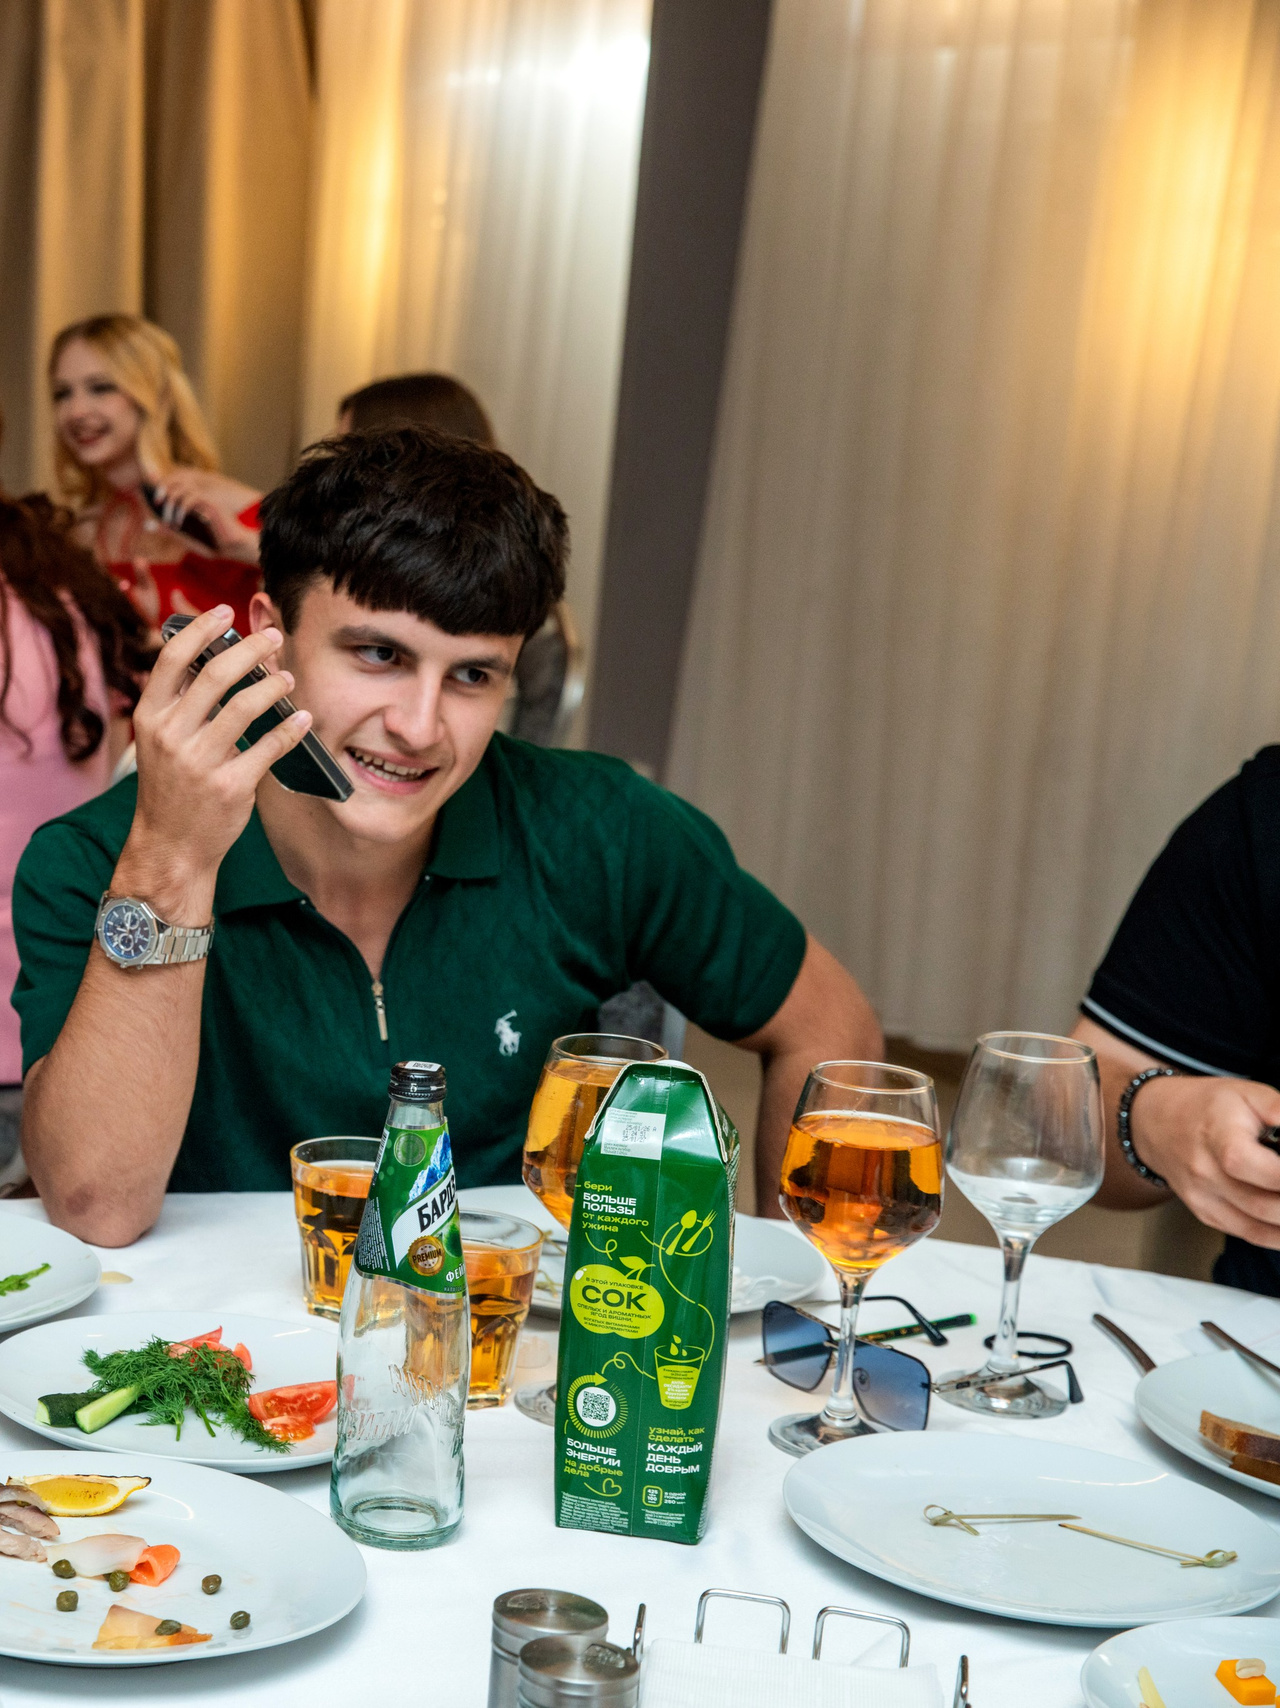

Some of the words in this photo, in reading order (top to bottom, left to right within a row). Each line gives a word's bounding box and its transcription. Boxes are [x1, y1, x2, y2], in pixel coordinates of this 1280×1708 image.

[584, 1181, 612, 1192] бери
[417, 1174, 455, 1233] БАРДЗ
[583, 1192, 637, 1206] БОЛЬШЕ
[582, 1201, 636, 1216] ПОЛЬЗЫ
[582, 1221, 619, 1233] ужина
[597, 1214, 649, 1227] каждого
[411, 1248, 442, 1264] PREMIUM
[445, 1263, 466, 1283] ФЕЙ
[609, 1281, 644, 1290] УПАКОВКЕ
[581, 1285, 647, 1311] СОК
[577, 1303, 602, 1312] СПЕЛЫХ
[608, 1310, 652, 1319] АРОМАТНЫХ
[649, 1426, 686, 1436] узнай,
[688, 1427, 705, 1435] как
[648, 1434, 695, 1443] сделать
[566, 1437, 617, 1456] БОЛЬШЕ
[647, 1442, 703, 1455] КАЖДЫЙ
[566, 1448, 621, 1467] ЭНЕРГИИ
[646, 1453, 681, 1464] ДЕНЬ
[563, 1466, 590, 1478] дела
[564, 1458, 577, 1467] на
[578, 1463, 624, 1477] добрые
[645, 1463, 700, 1474] ДОБРЫМ
